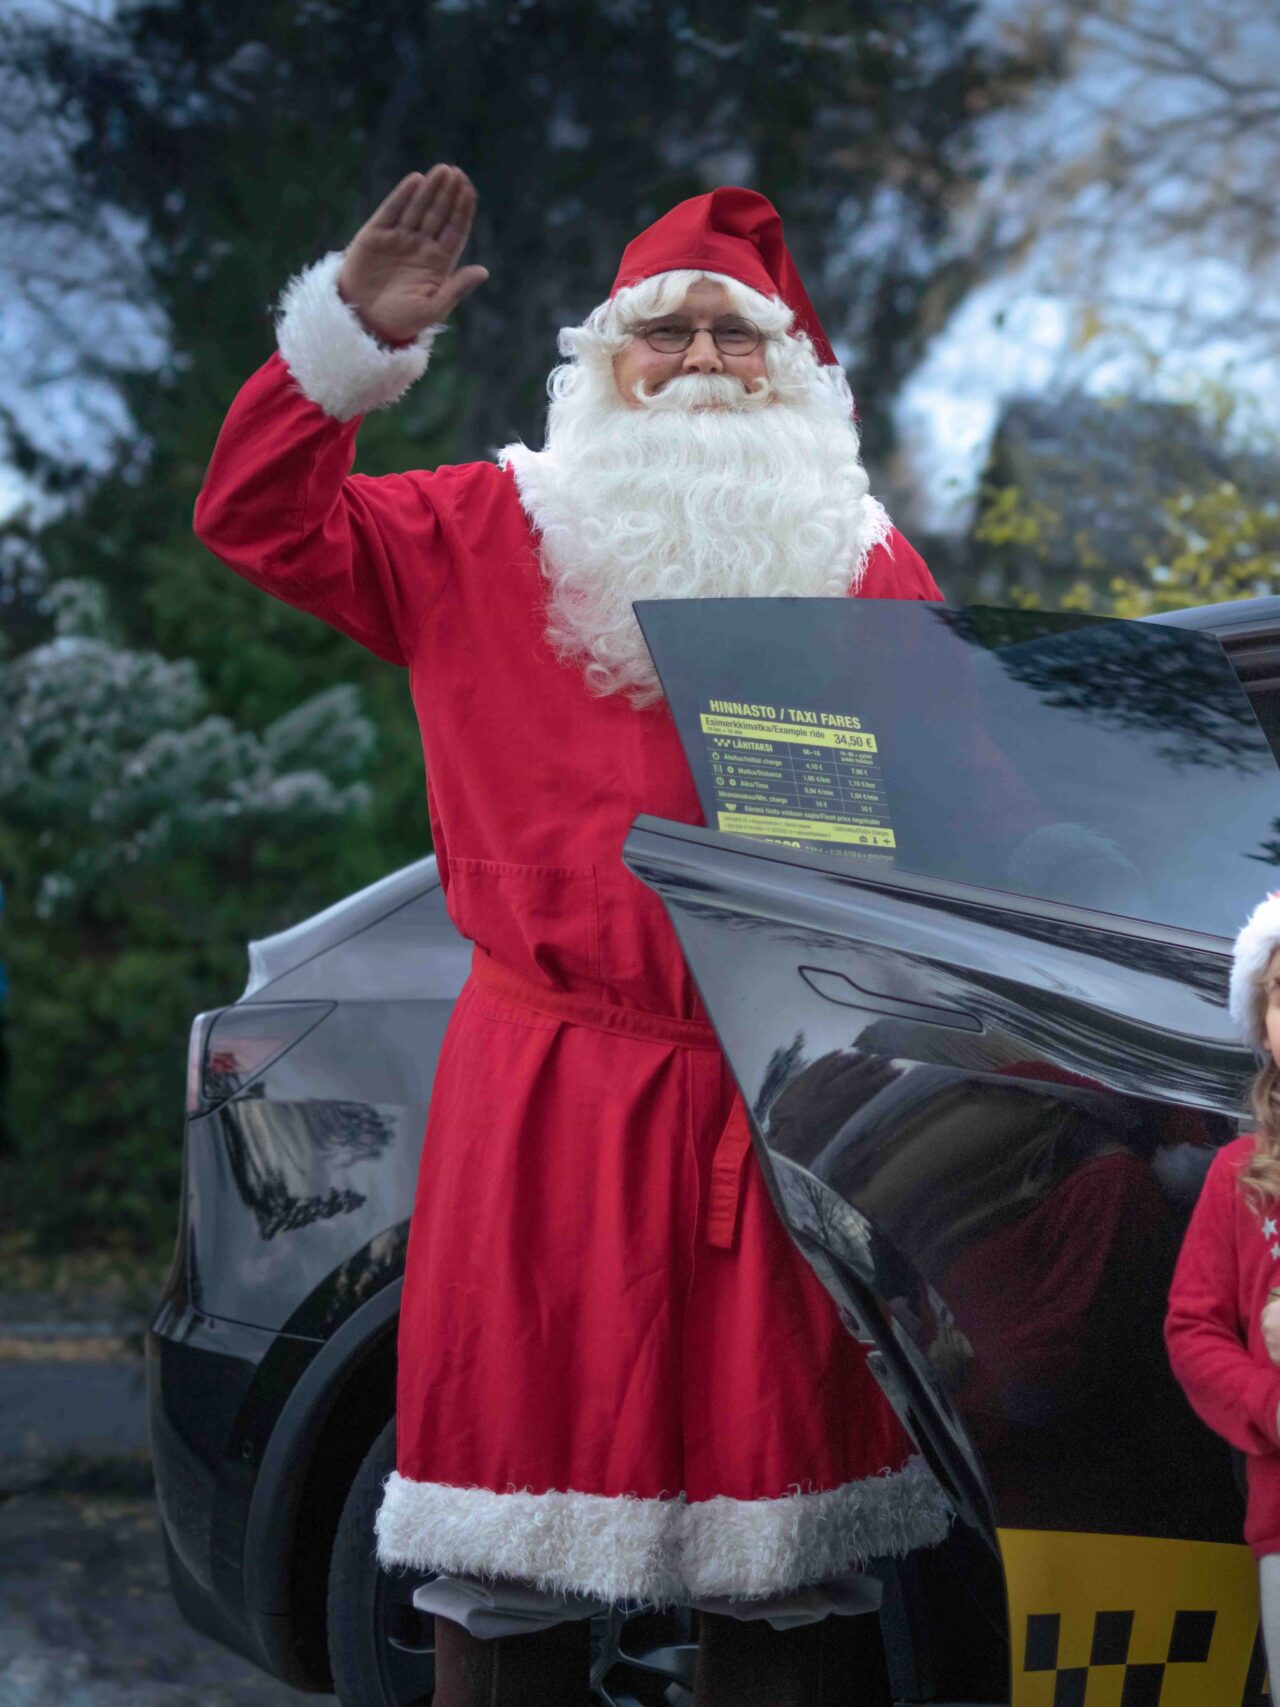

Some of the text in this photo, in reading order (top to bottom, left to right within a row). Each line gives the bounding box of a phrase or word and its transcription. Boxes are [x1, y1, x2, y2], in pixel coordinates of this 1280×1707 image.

[710, 700, 861, 729] HINNASTO / TAXI FARES
[705, 717, 873, 748] Esimerkkimatka/Example ride 34,50 €
[732, 738, 773, 752] LÄHITAKSI
